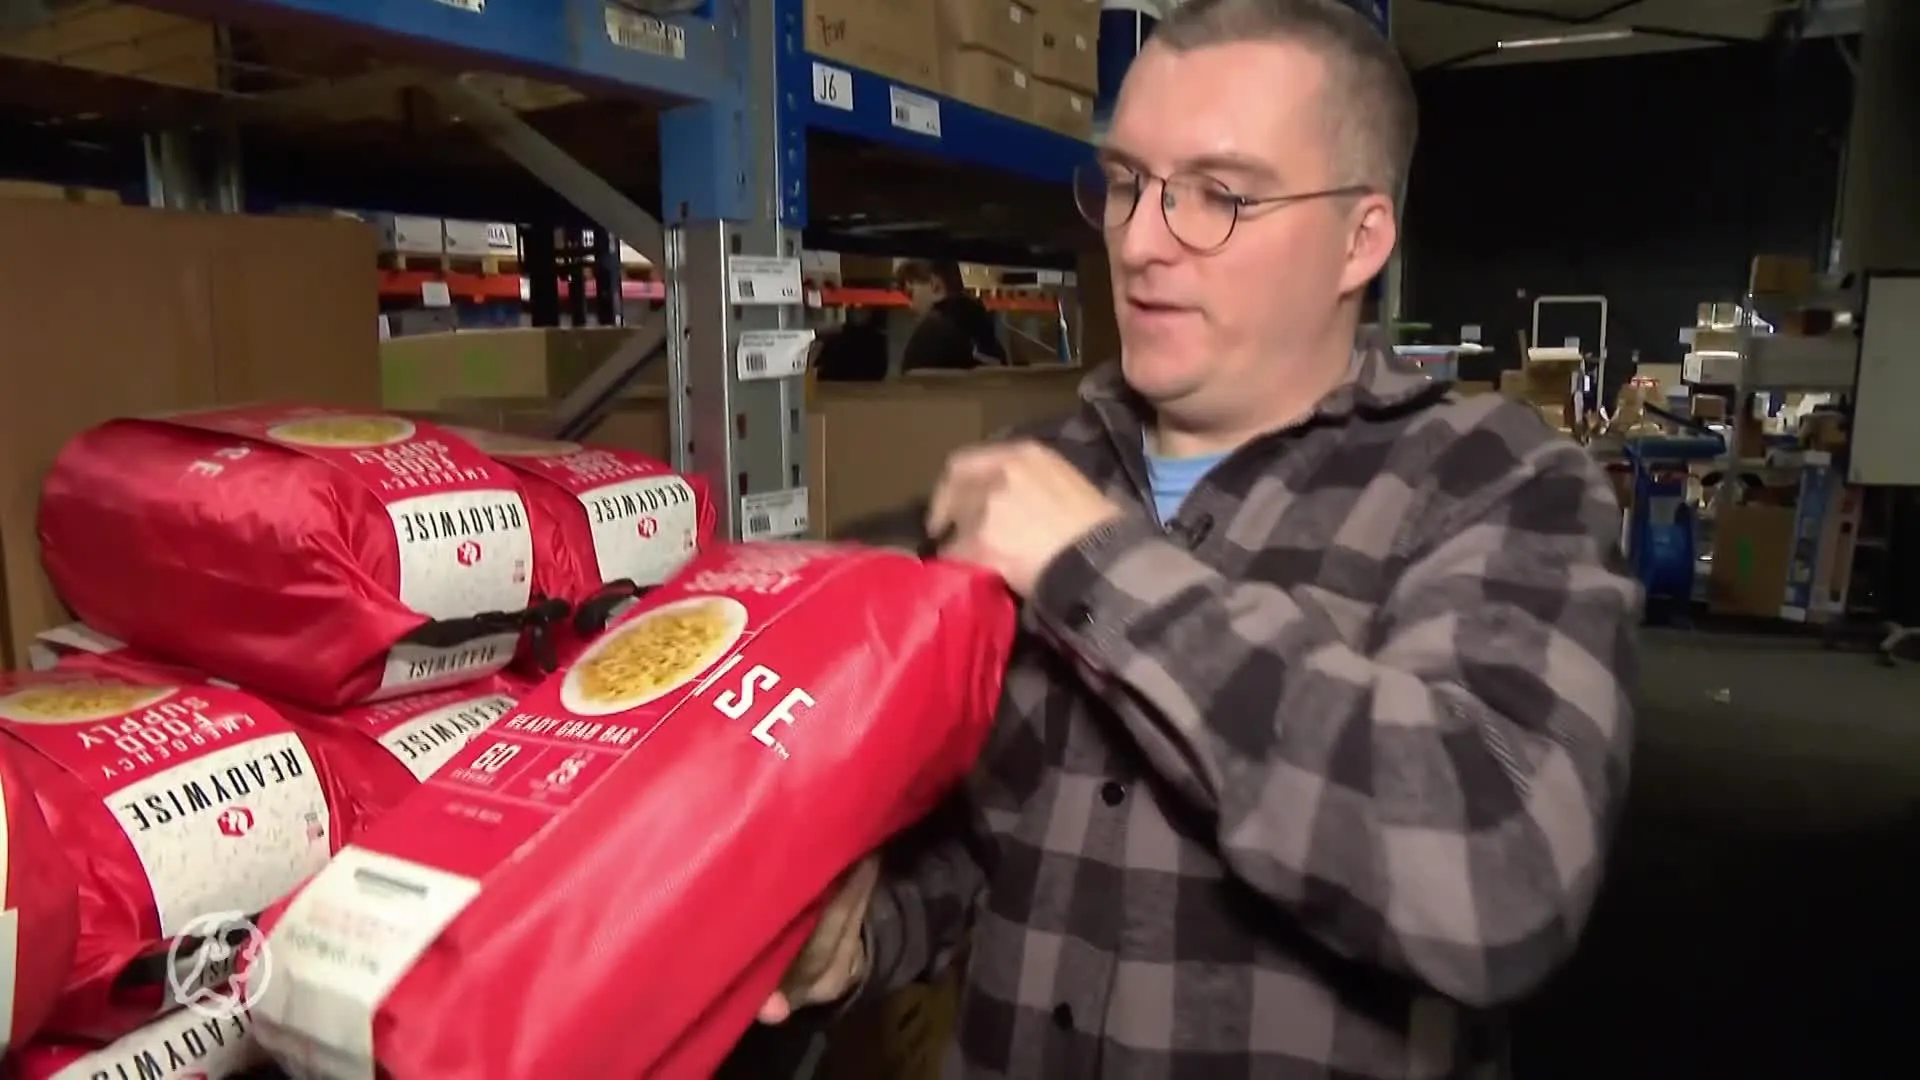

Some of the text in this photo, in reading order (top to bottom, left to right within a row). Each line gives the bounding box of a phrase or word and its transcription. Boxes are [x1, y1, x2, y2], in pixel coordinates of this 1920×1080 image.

[819, 69, 838, 102] J6
[401, 502, 522, 544] READYWISE
[591, 482, 690, 524] READYWISE
[76, 696, 210, 750] SUPPLY
[114, 711, 216, 755] FOOD
[504, 702, 640, 745] READY GRAB BAG
[101, 713, 256, 781] EMERGENCY
[470, 741, 523, 774] 60
[124, 747, 303, 832] READYWISE
